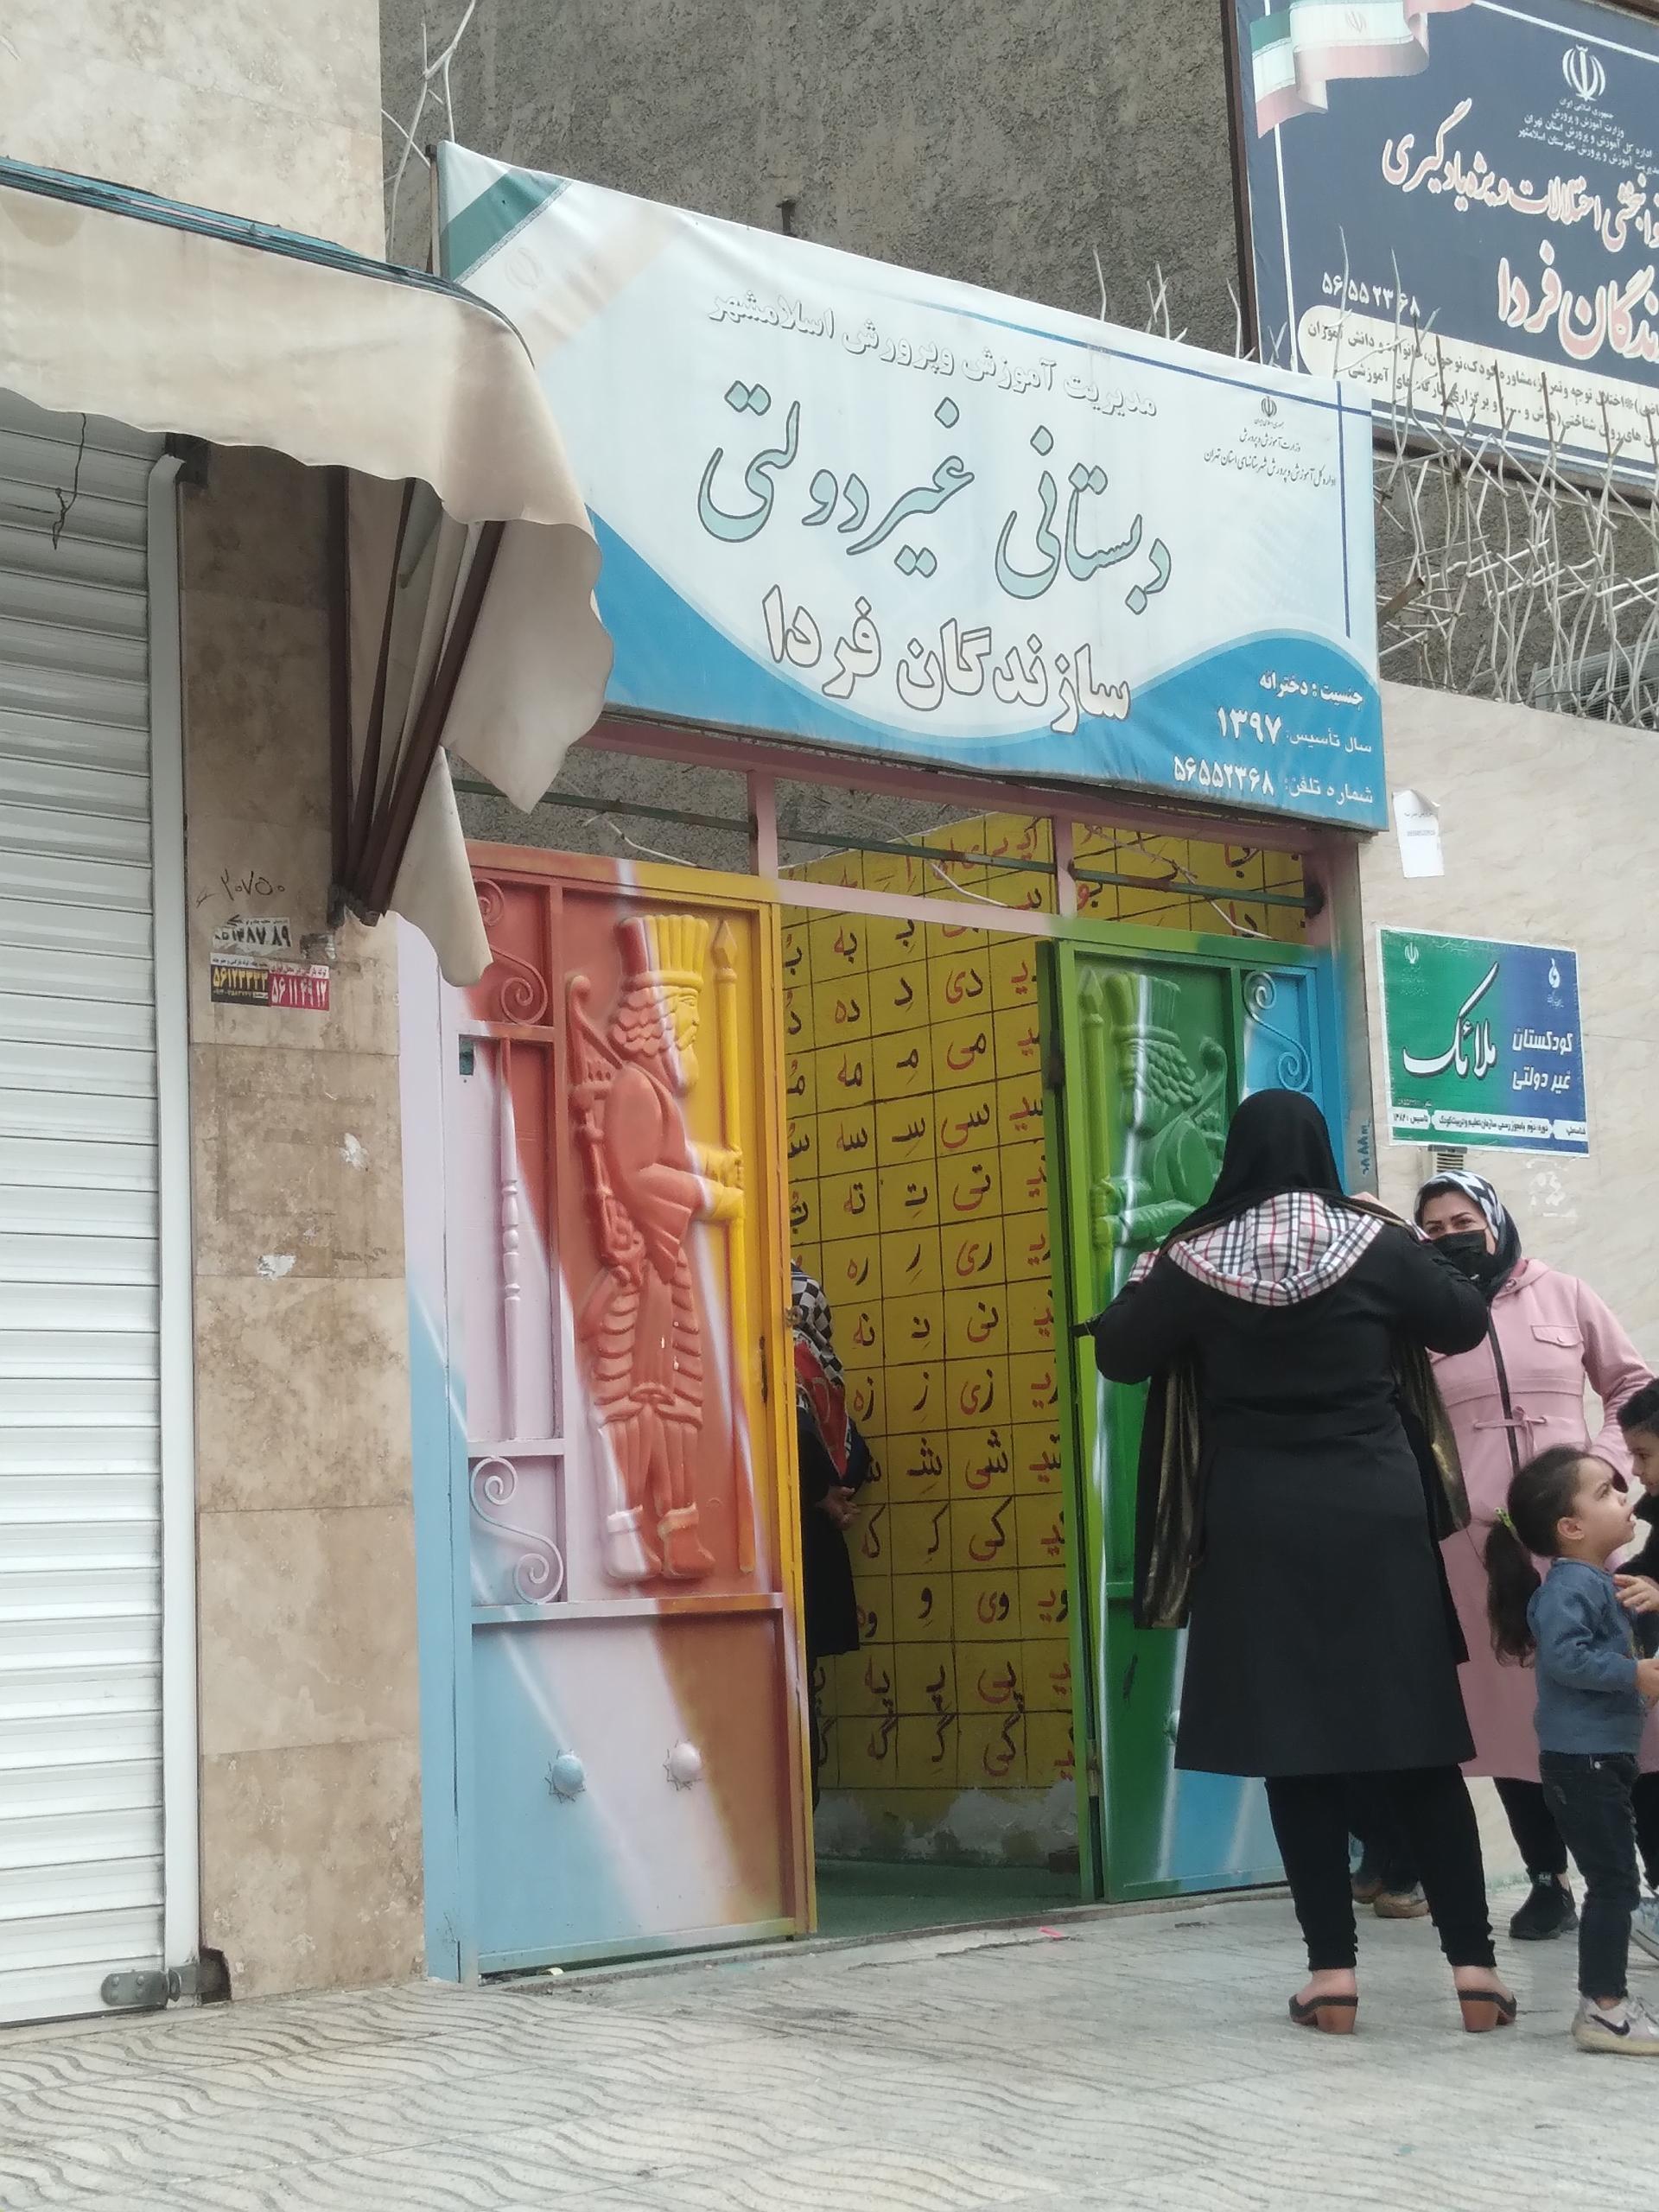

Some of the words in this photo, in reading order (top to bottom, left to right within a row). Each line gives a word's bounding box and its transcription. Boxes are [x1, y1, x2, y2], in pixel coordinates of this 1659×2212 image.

[1497, 239, 1562, 334] فردا
[708, 291, 836, 340] اسلامشهر
[1558, 264, 1659, 362] ندگان
[962, 347, 1057, 391] آموزش
[1064, 372, 1159, 416] مدیریت
[995, 424, 1173, 616] دبستانی
[761, 583, 883, 701] فردا
[895, 616, 1133, 735] سازندگان
[1259, 670, 1309, 698] دخترانه
[1319, 684, 1363, 712] جنسیت
[1217, 706, 1282, 746] ۱۳۹۷
[1344, 735, 1372, 753] سال
[1173, 754, 1275, 798] ۵۶۵۵۲۳۶۸
[1326, 783, 1373, 806] شماره
[1512, 1027, 1574, 1056] کودکستان
[1512, 1065, 1549, 1091] دولتی
[1550, 1070, 1572, 1095] غیر
